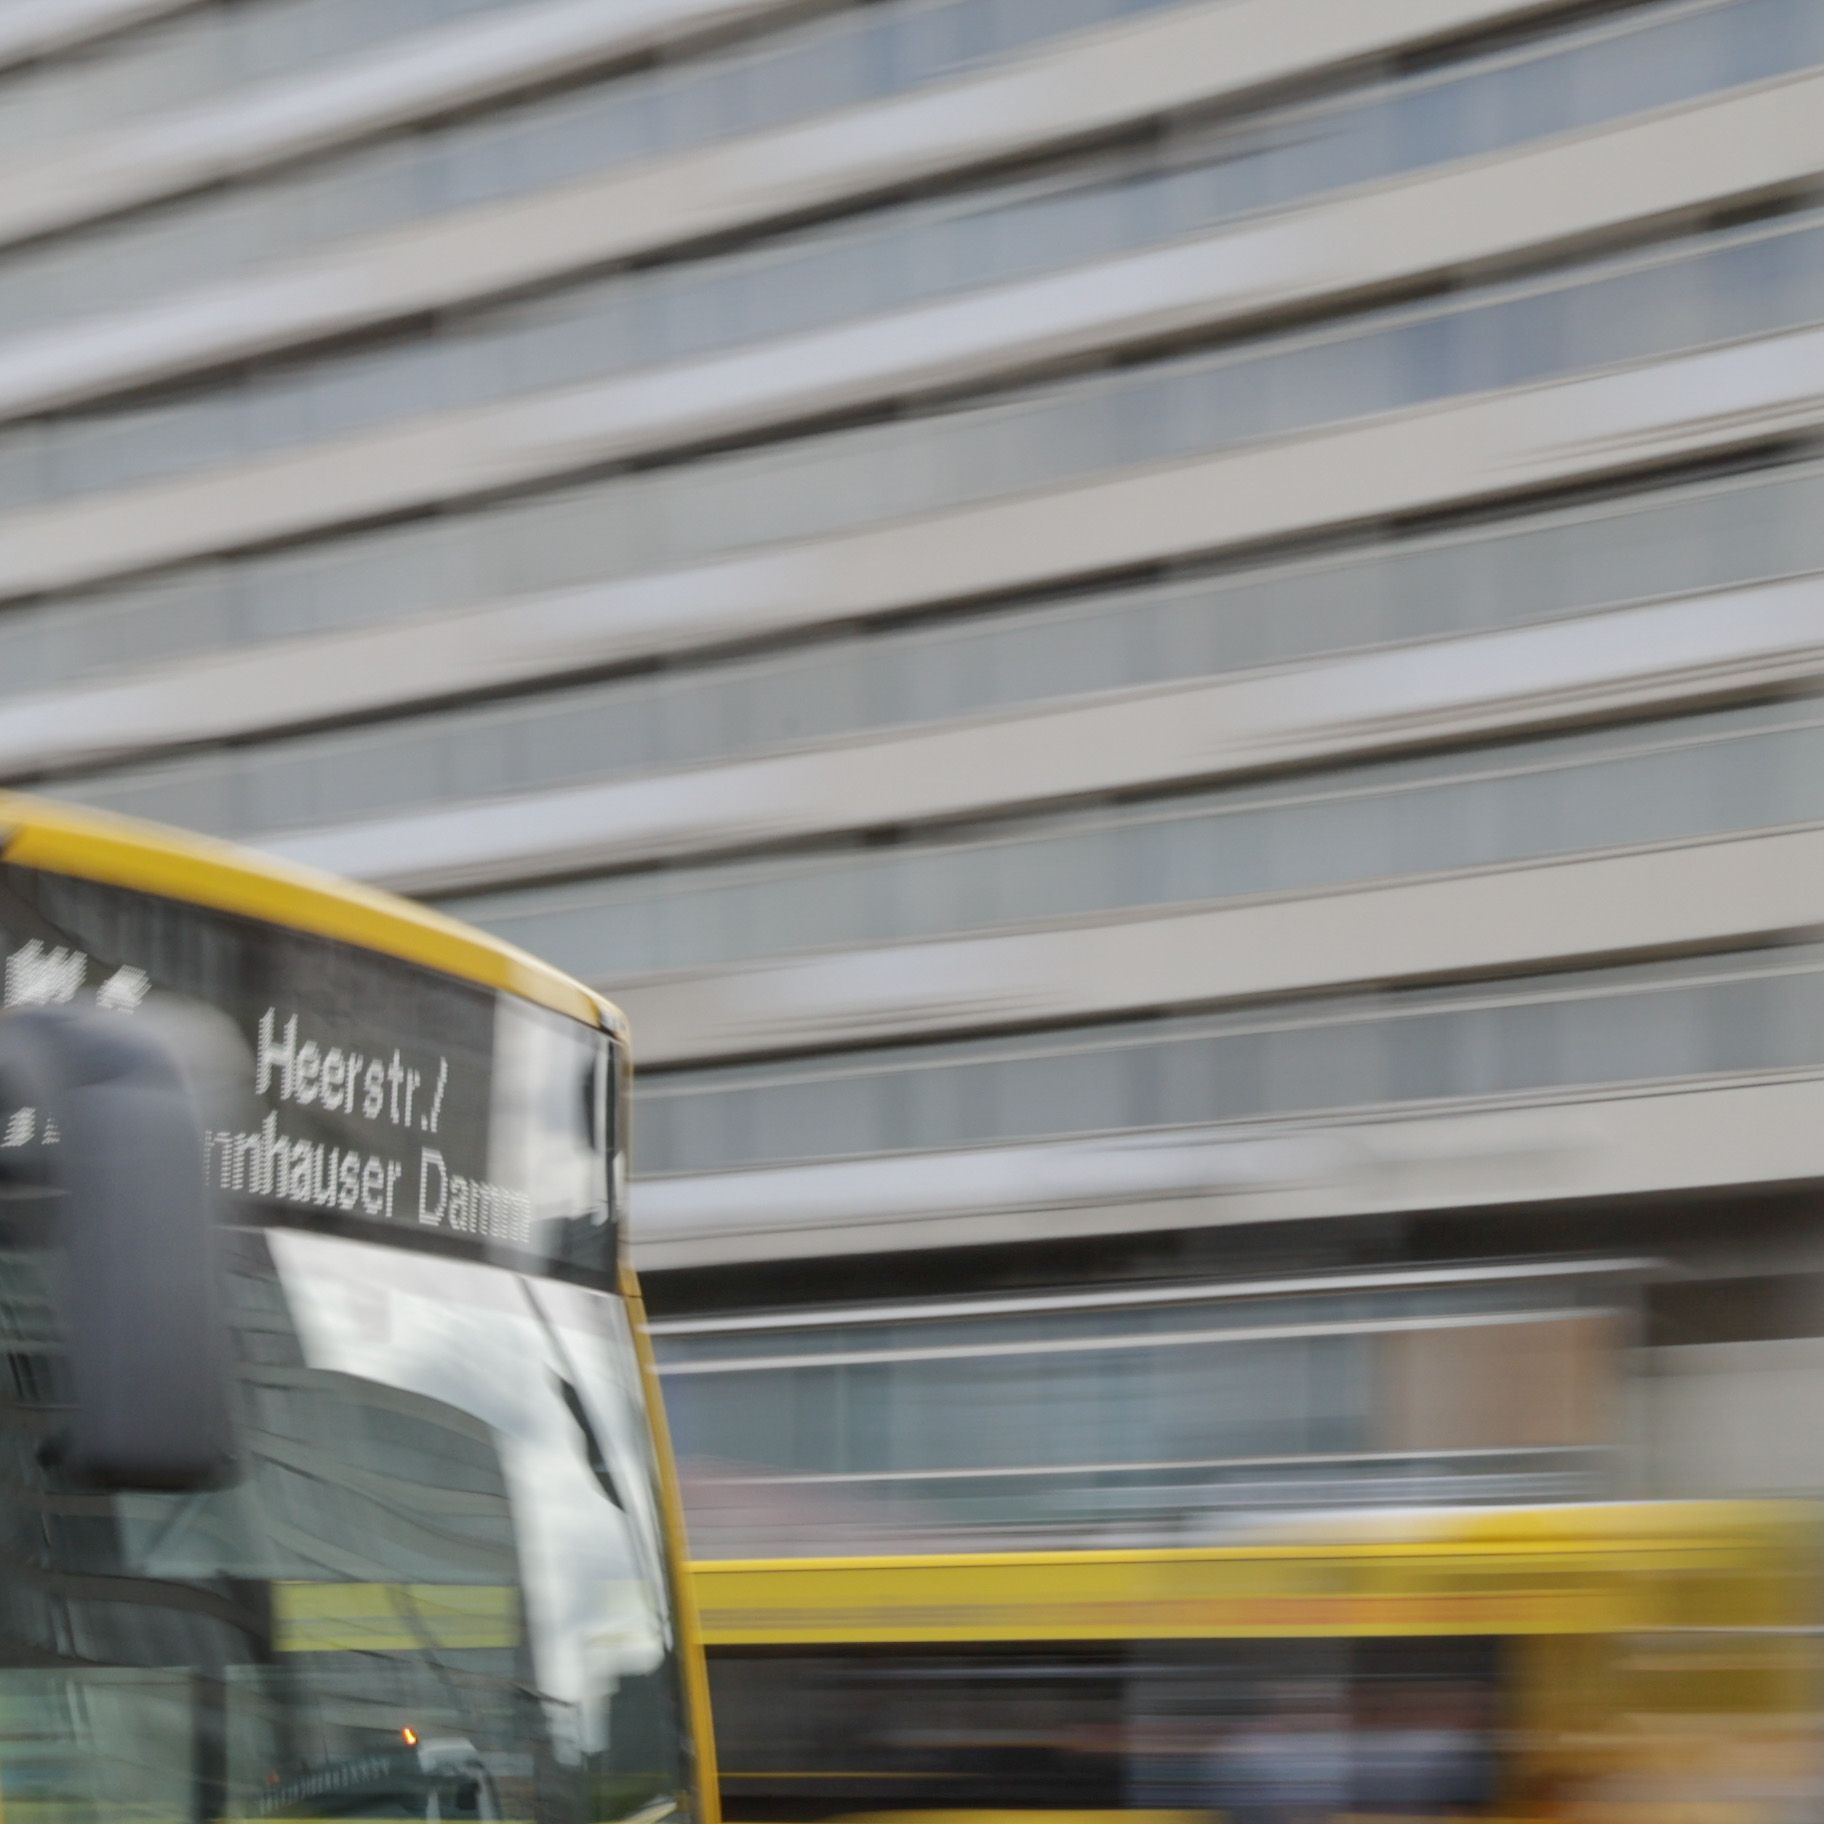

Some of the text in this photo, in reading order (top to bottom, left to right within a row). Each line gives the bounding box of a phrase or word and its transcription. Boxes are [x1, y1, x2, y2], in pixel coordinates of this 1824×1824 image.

[256, 1006, 448, 1133] Heerstr./
[202, 1110, 530, 1244] nnhauser Damm
